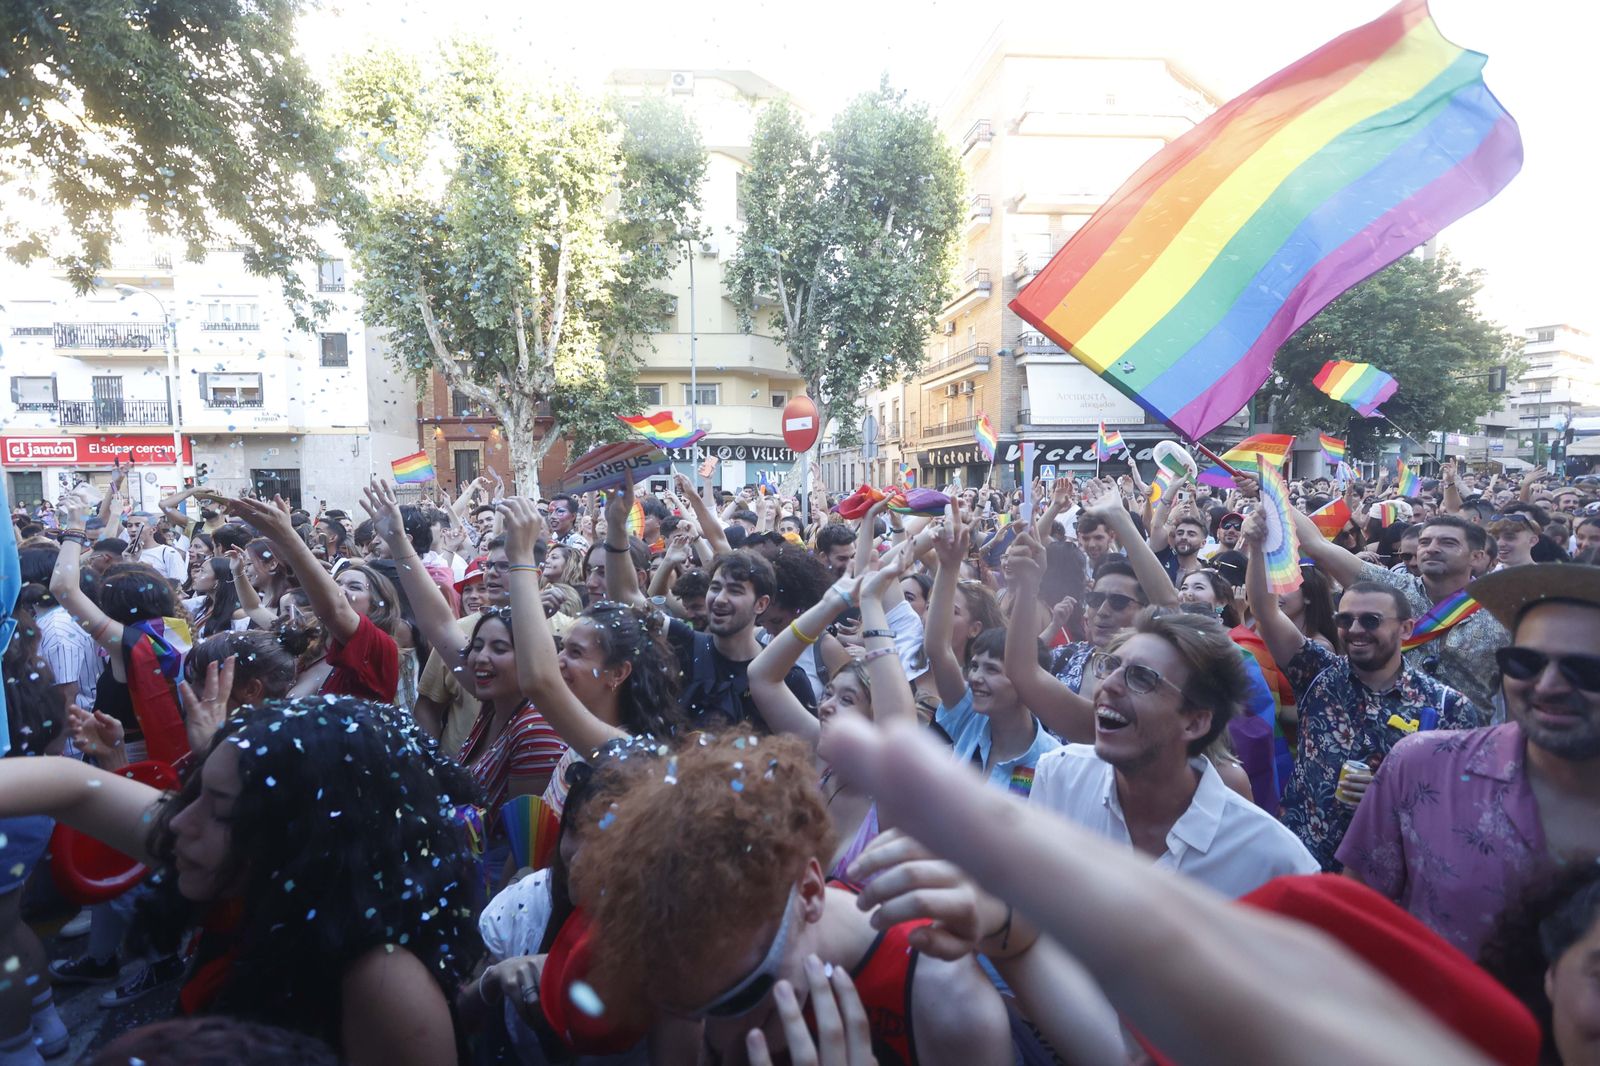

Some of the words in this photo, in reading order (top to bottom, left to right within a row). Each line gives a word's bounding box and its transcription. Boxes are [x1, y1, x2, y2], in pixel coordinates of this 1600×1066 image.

[12, 442, 26, 455] el
[27, 441, 72, 458] jamón
[88, 443, 100, 454] El
[136, 445, 175, 454] cercan
[928, 446, 991, 466] Victoria
